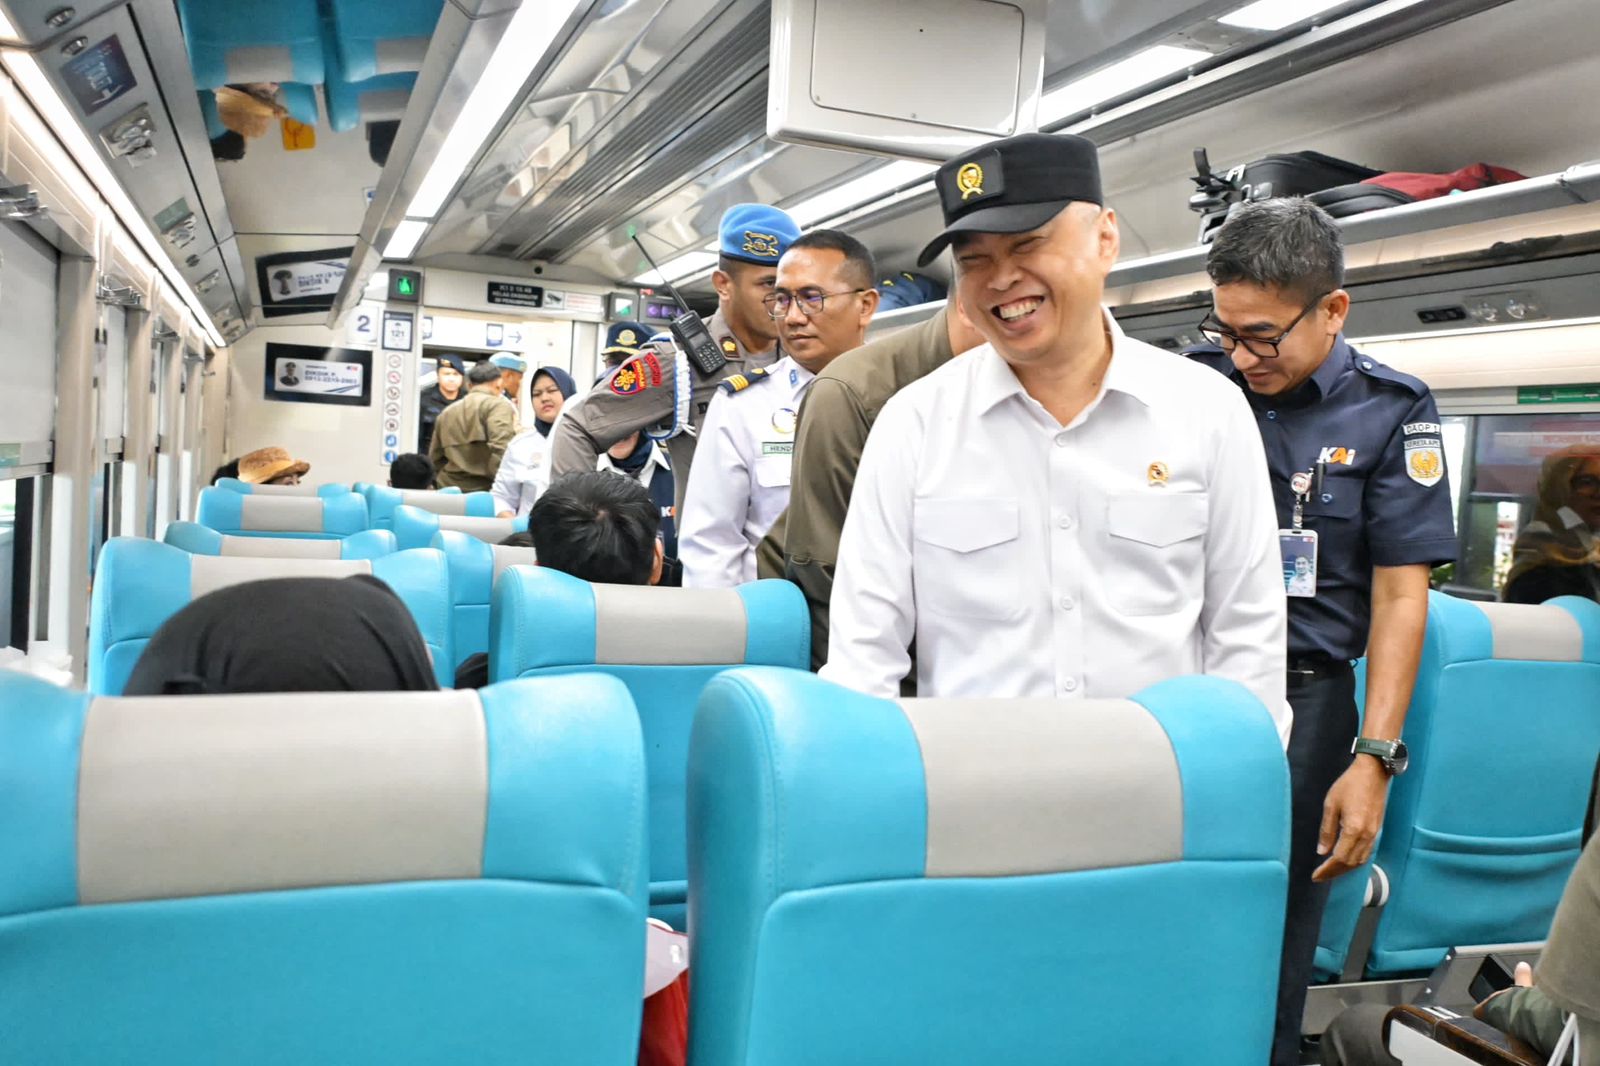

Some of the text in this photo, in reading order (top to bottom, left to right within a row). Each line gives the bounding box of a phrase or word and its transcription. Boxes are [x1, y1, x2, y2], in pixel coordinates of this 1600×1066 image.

[357, 315, 371, 333] 2
[391, 329, 405, 337] 121
[1319, 446, 1356, 466] KAI
